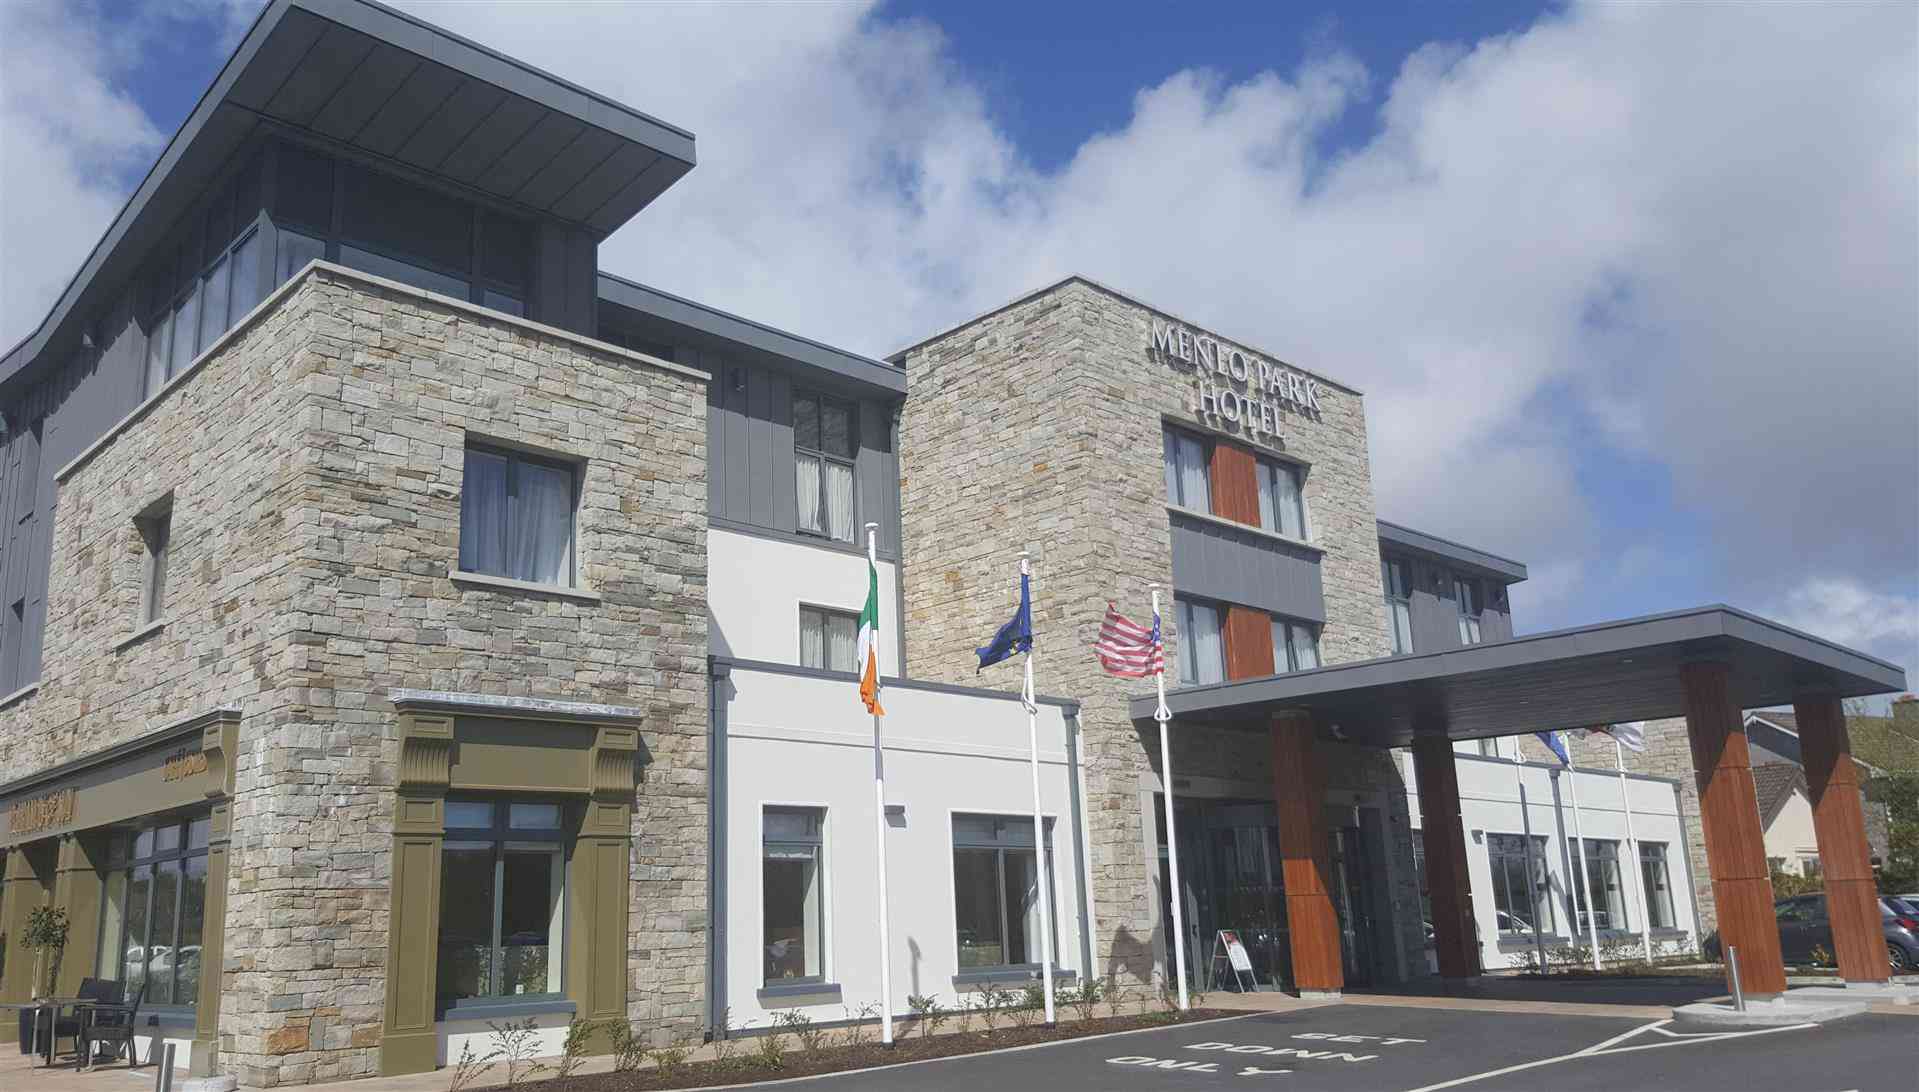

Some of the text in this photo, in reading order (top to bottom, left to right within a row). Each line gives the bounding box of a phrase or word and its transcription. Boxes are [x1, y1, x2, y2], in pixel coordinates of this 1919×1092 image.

[1152, 319, 1321, 412] MENLO PARK
[1200, 379, 1285, 440] HOTEL
[1291, 1032, 1427, 1045] SET
[1182, 1042, 1379, 1062] DOWN
[1105, 1056, 1293, 1076] ONLY
